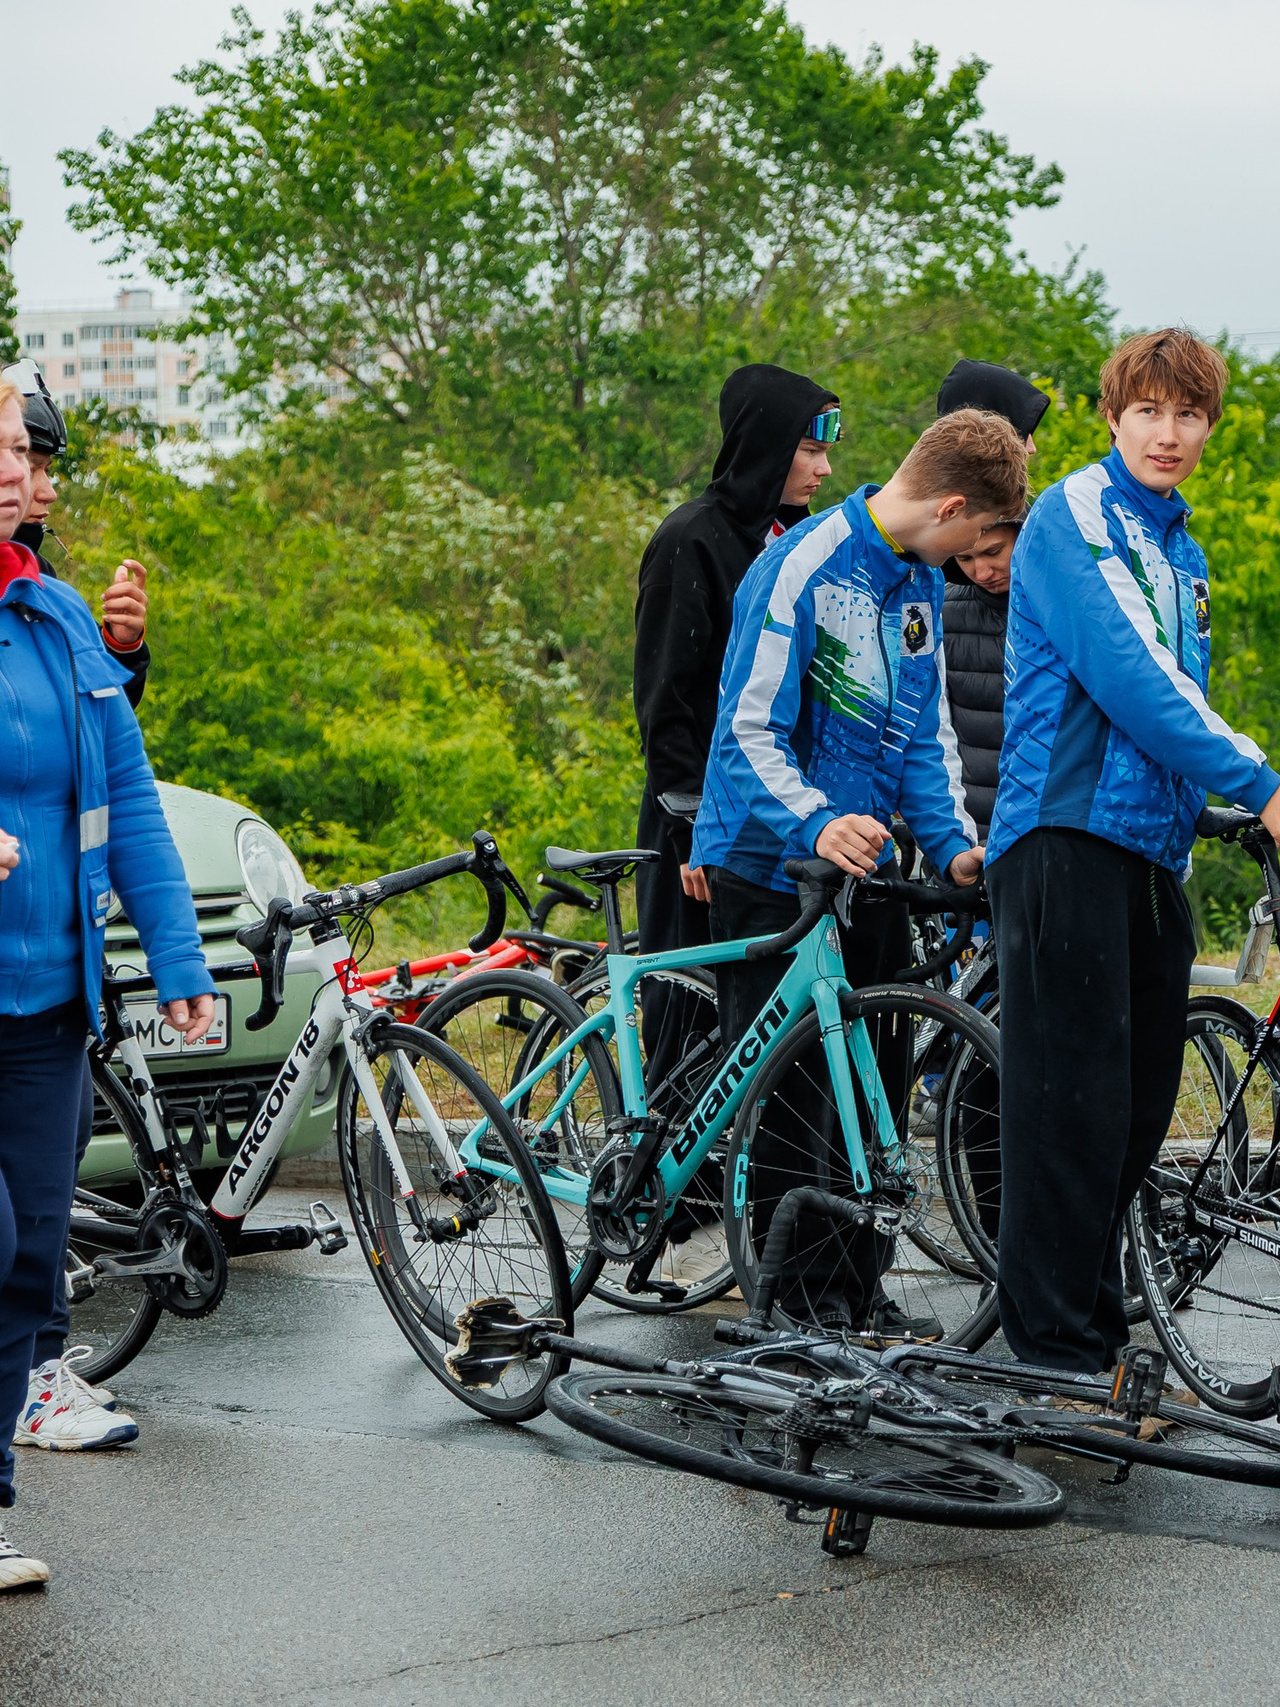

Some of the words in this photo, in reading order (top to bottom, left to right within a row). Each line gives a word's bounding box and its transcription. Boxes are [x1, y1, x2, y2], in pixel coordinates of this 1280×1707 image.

[636, 957, 660, 966] SPRINT
[228, 1057, 300, 1197] ARGON
[295, 1018, 320, 1060] 18
[670, 989, 791, 1168] Bianchi
[1139, 1245, 1232, 1396] MARCHISIO
